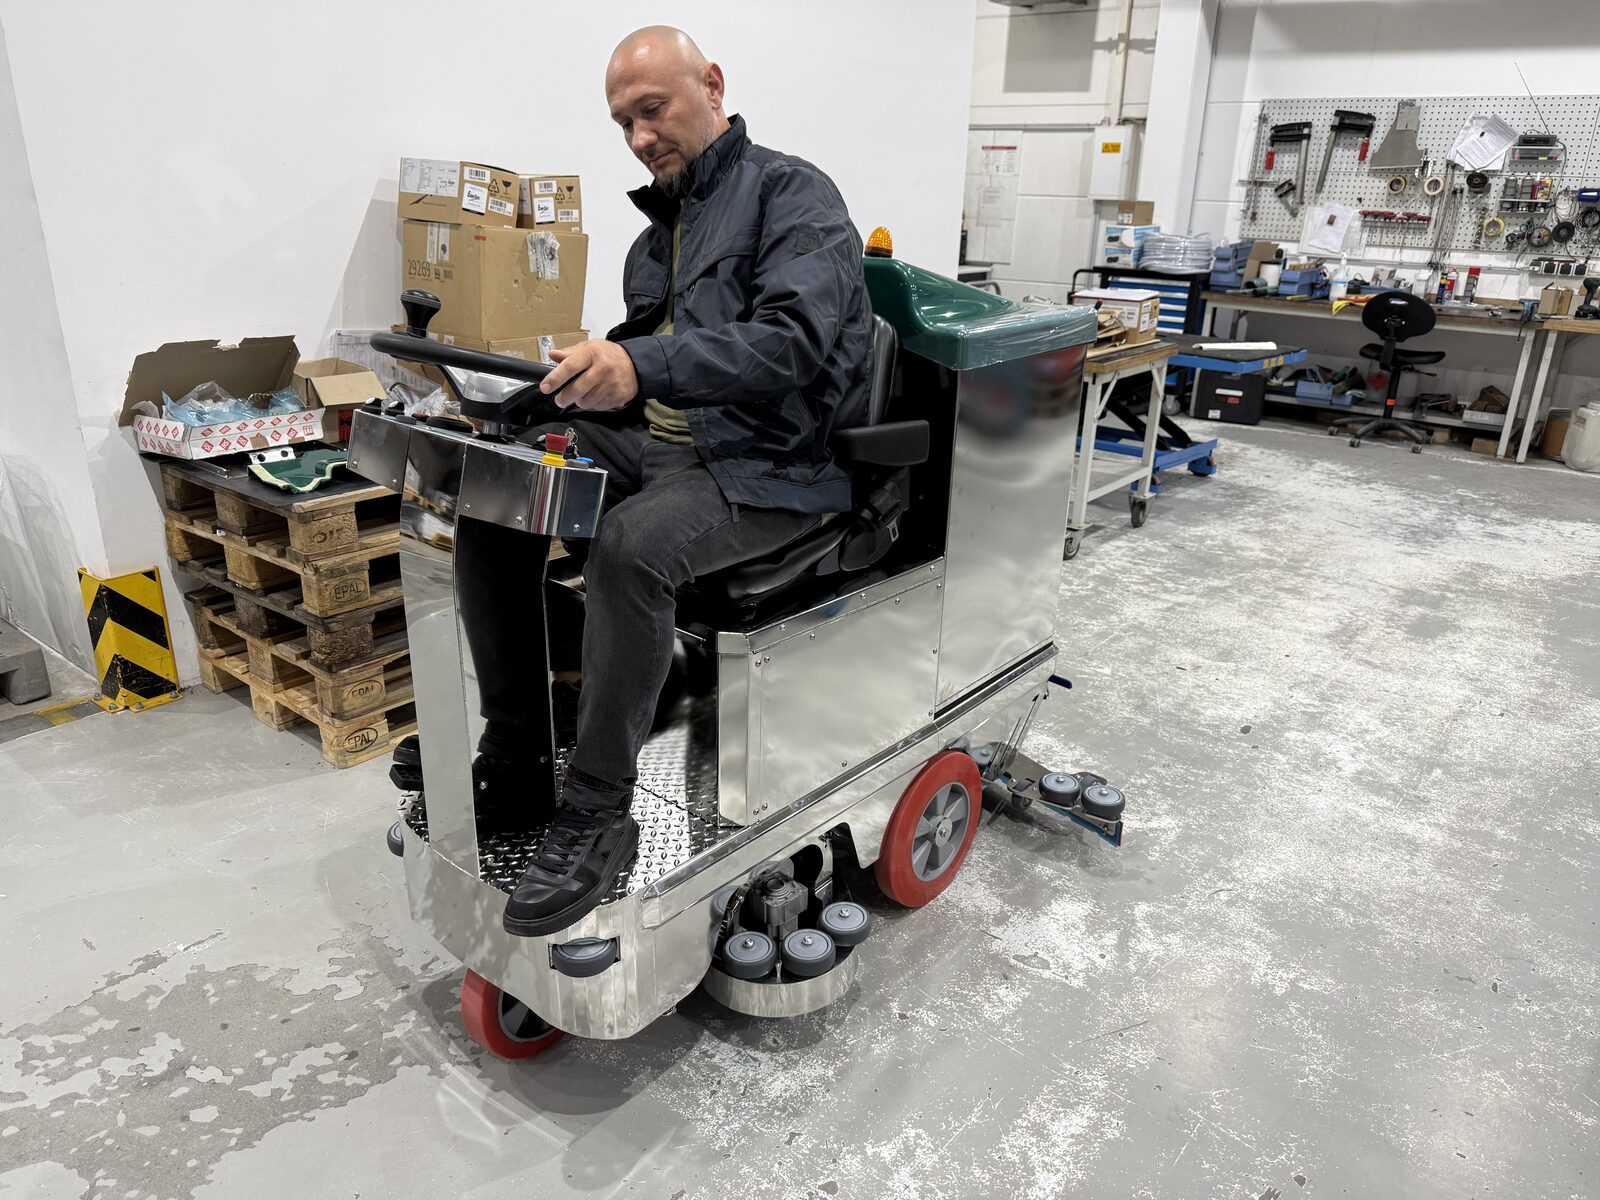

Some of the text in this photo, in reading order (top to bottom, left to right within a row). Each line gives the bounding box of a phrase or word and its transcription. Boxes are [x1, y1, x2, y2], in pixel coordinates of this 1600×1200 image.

[407, 259, 431, 277] 29269
[334, 582, 362, 600] EPAL
[347, 731, 373, 748] EPAL
